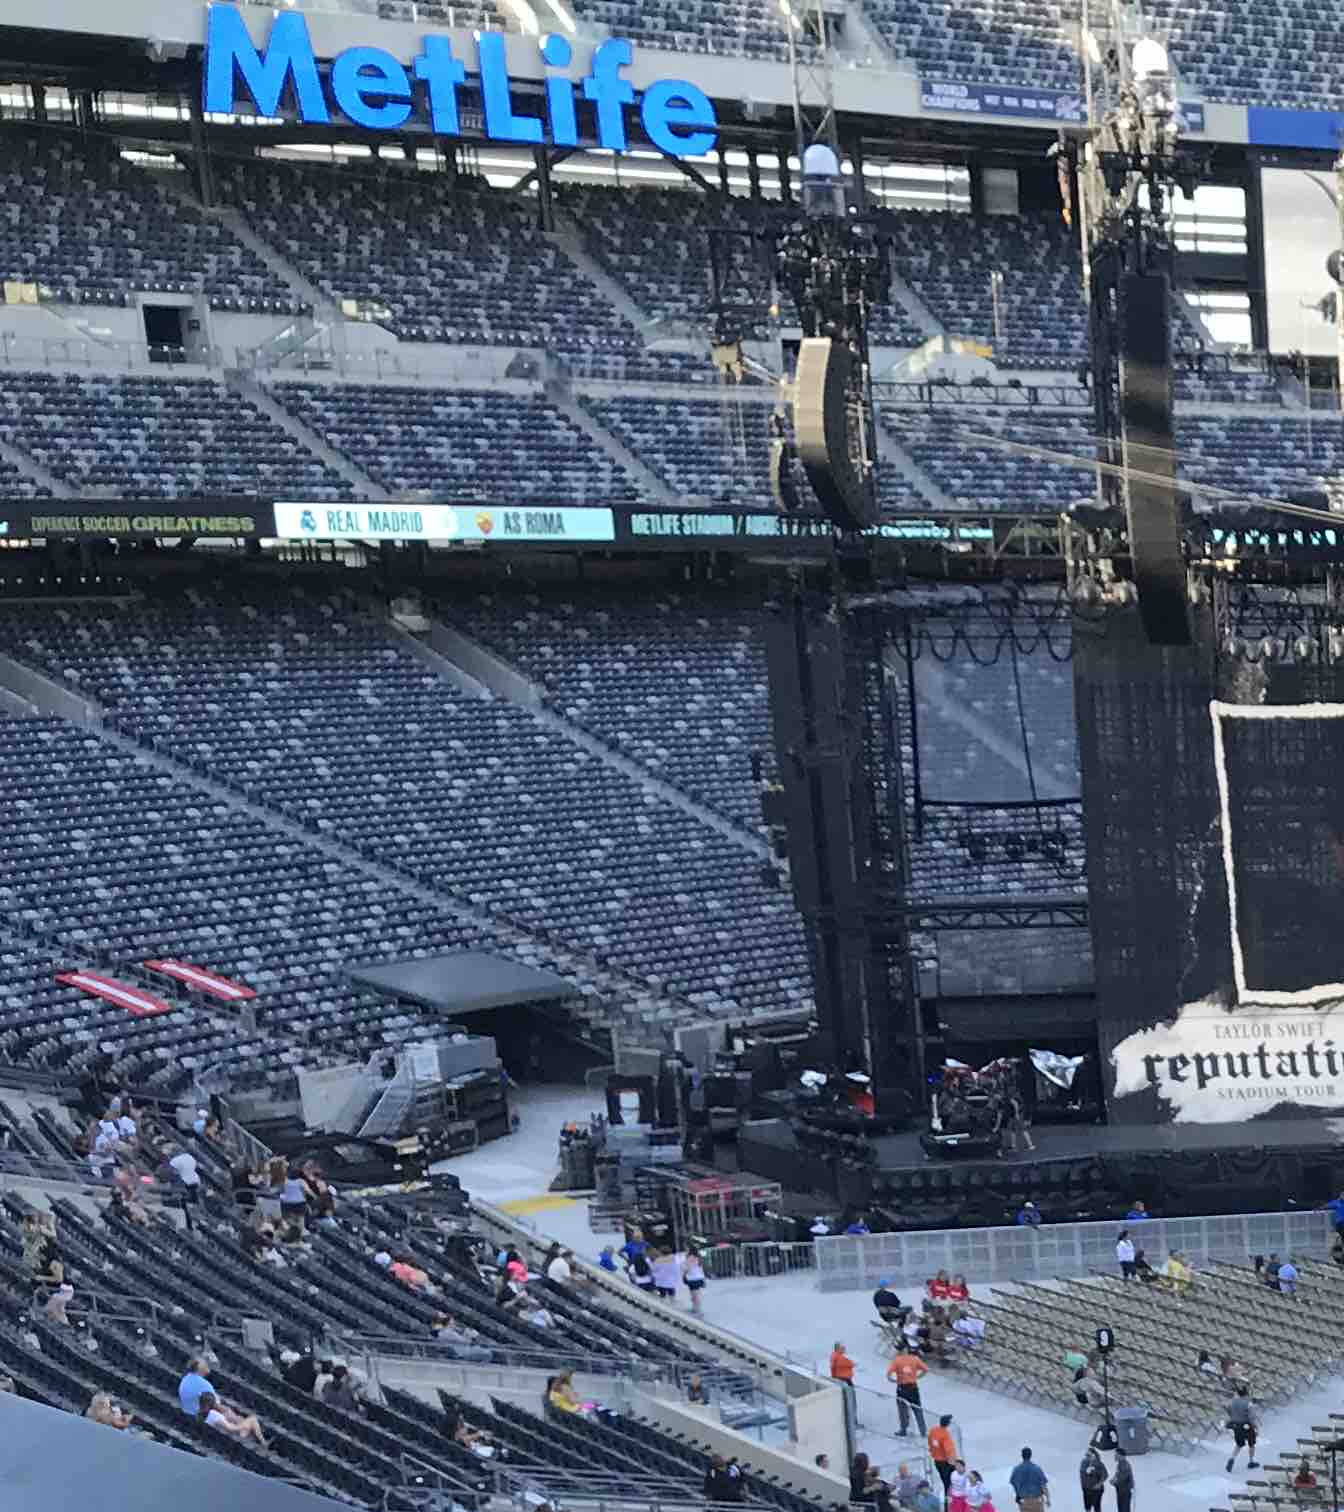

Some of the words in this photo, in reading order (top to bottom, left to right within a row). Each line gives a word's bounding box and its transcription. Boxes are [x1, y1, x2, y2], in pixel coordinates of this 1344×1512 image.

[202, 2, 719, 158] MetLife
[132, 516, 255, 532] GREATNESS
[327, 511, 360, 533] REAL
[367, 511, 424, 533] MADRID
[503, 512, 523, 535] AS
[526, 512, 566, 535] ROMA
[1214, 1023, 1273, 1040] TAYLOR
[1277, 1021, 1326, 1039] SWIFT
[1216, 1086, 1289, 1101] STADIUM
[1291, 1083, 1336, 1098] TOUR
